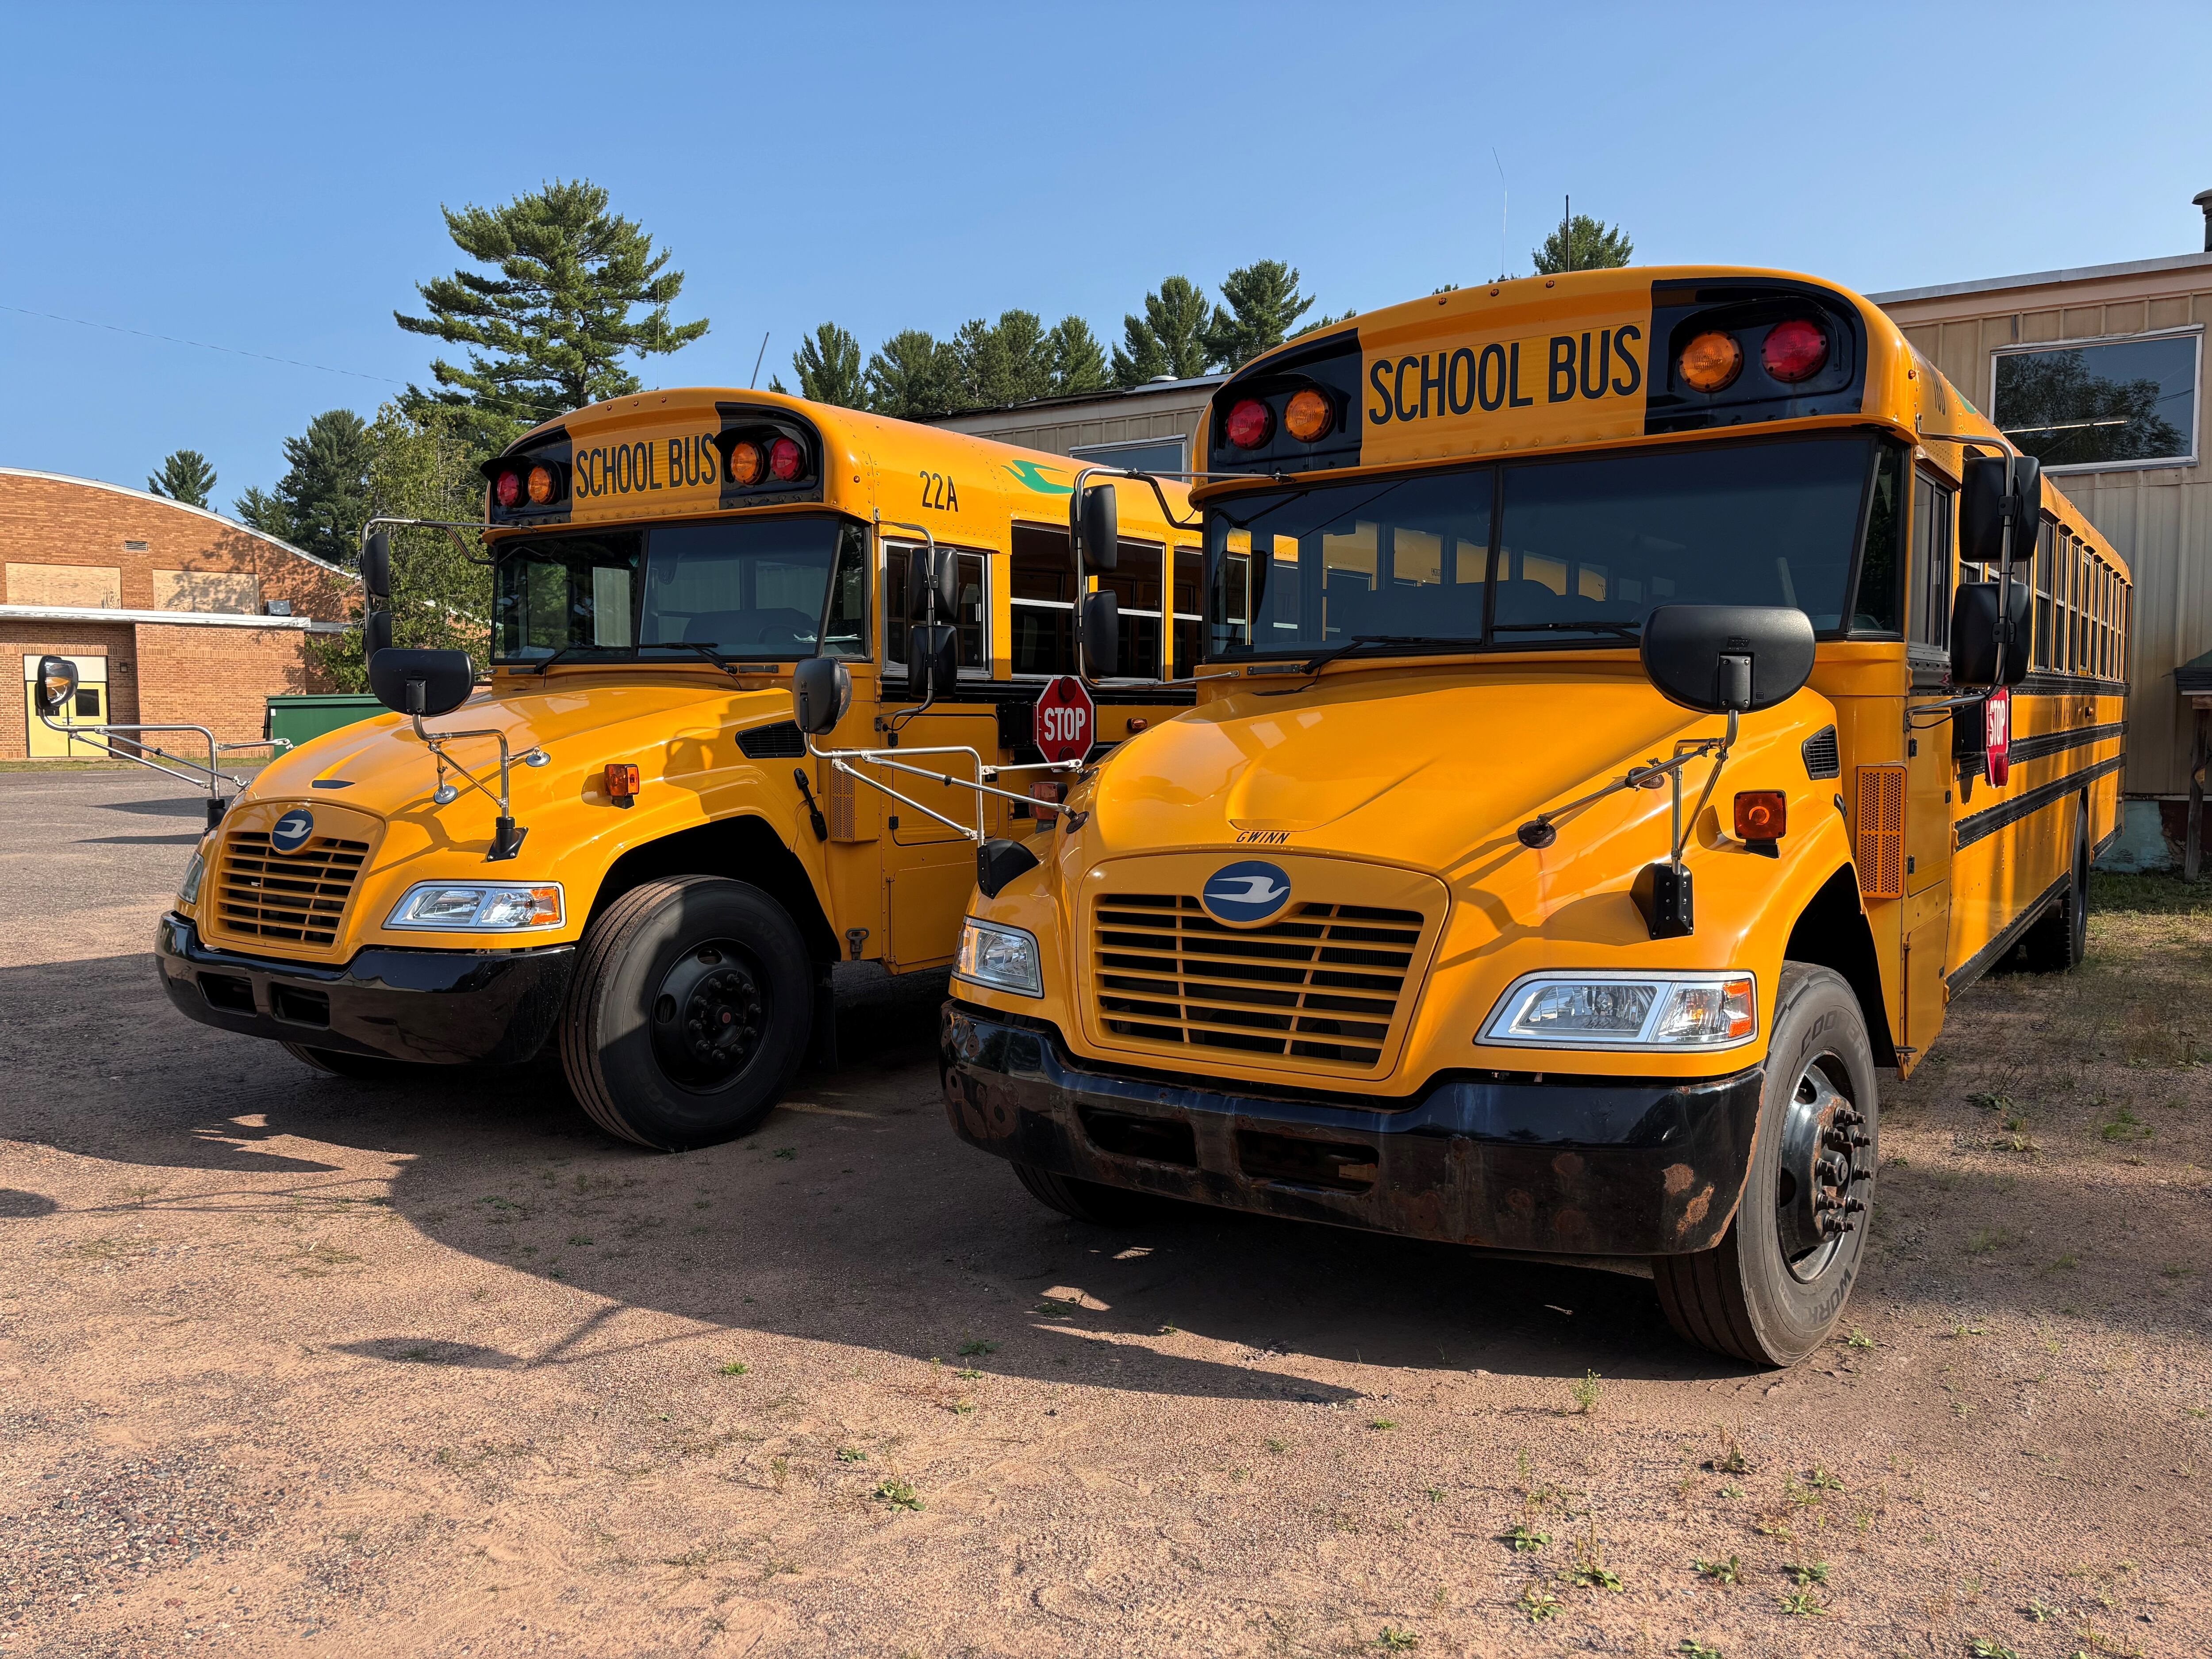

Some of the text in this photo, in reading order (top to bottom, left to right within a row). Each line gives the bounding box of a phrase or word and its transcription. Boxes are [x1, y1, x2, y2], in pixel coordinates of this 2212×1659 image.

[1369, 325, 1641, 425] SCHOOL BUS
[576, 434, 716, 498] SCHOOL BUS
[920, 470, 959, 512] 22A
[1044, 707, 1086, 741] STOP
[1989, 700, 2005, 745] STOP
[1236, 831, 1290, 844] GWINN
[1801, 1010, 1866, 1060] COOPER
